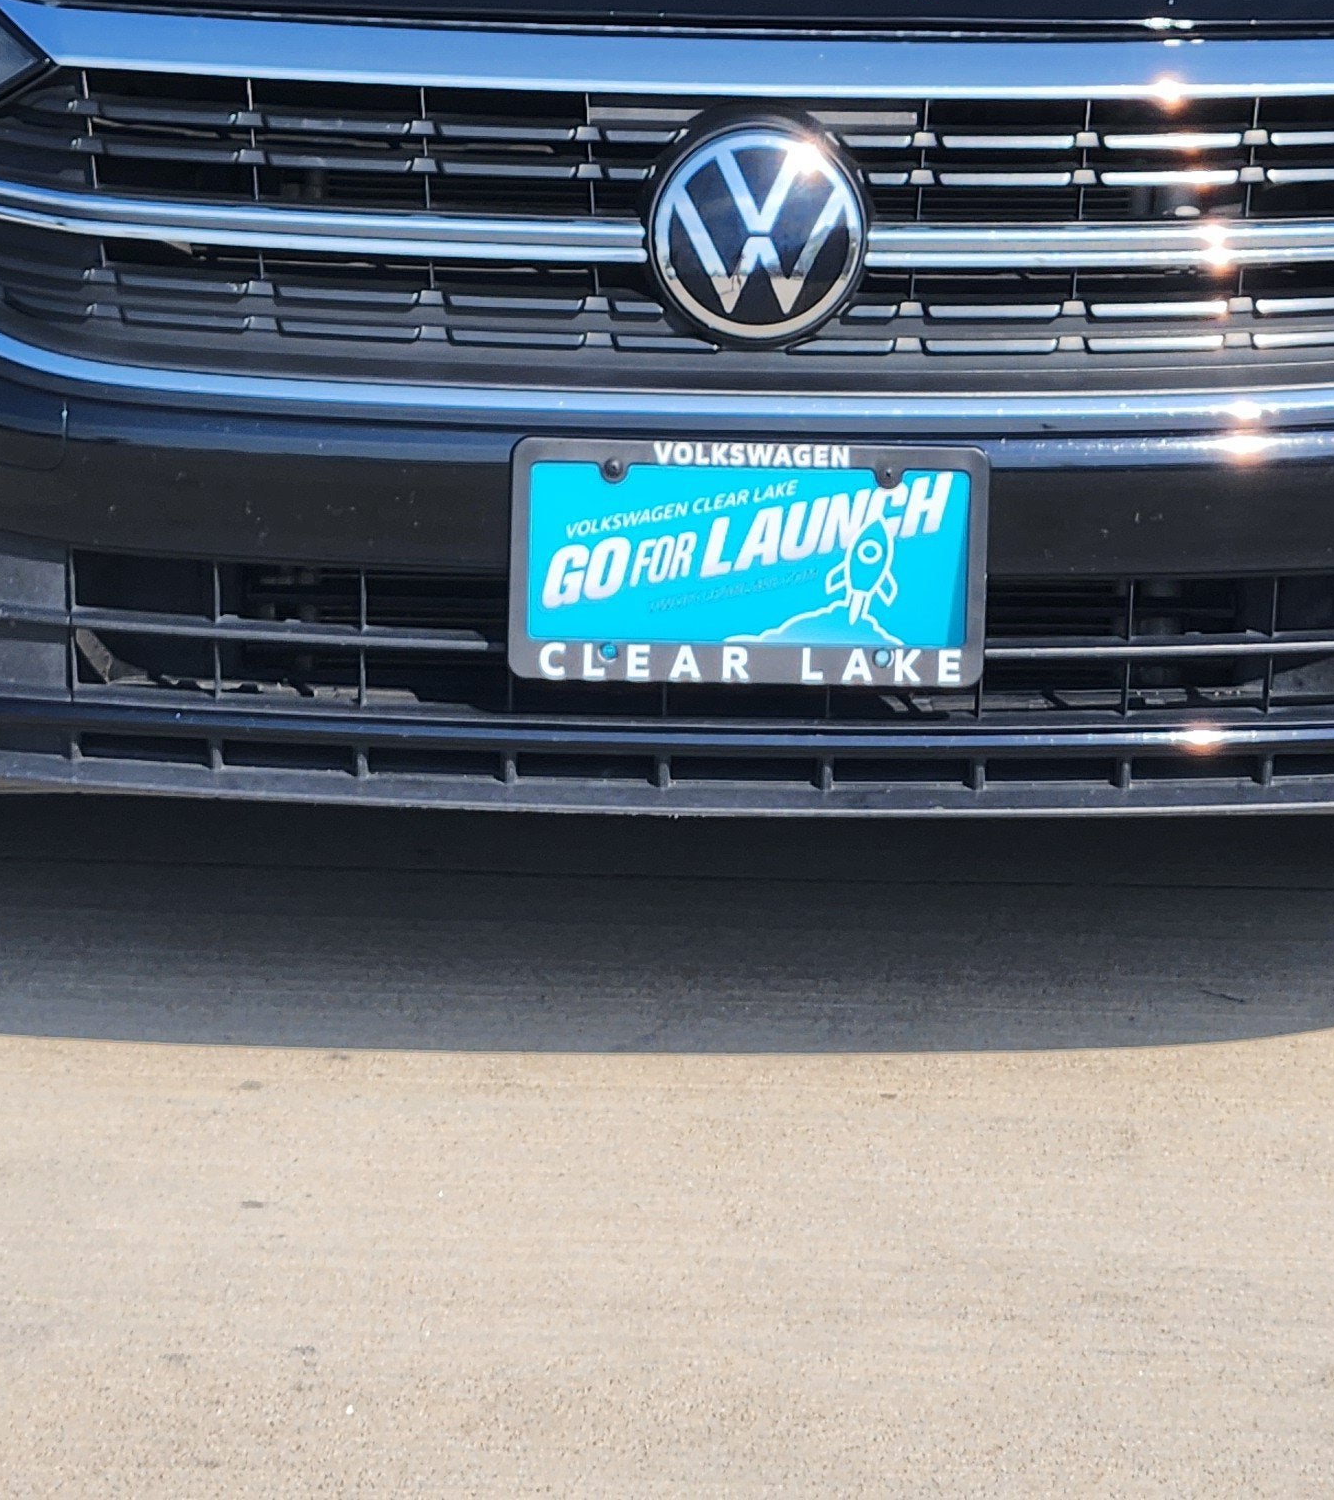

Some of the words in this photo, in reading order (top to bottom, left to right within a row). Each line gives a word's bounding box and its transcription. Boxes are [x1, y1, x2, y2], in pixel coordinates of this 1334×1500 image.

[653, 441, 851, 469] VOLKSWAGEN
[565, 502, 688, 538] VOLKSWAGEN
[692, 488, 749, 517] CLEAR
[753, 479, 799, 505] LAKE
[541, 536, 631, 609] GO
[631, 531, 697, 587] FOR
[699, 471, 954, 579] LAUNCH
[538, 642, 749, 681] CLEAR
[800, 647, 963, 683] LAKE
